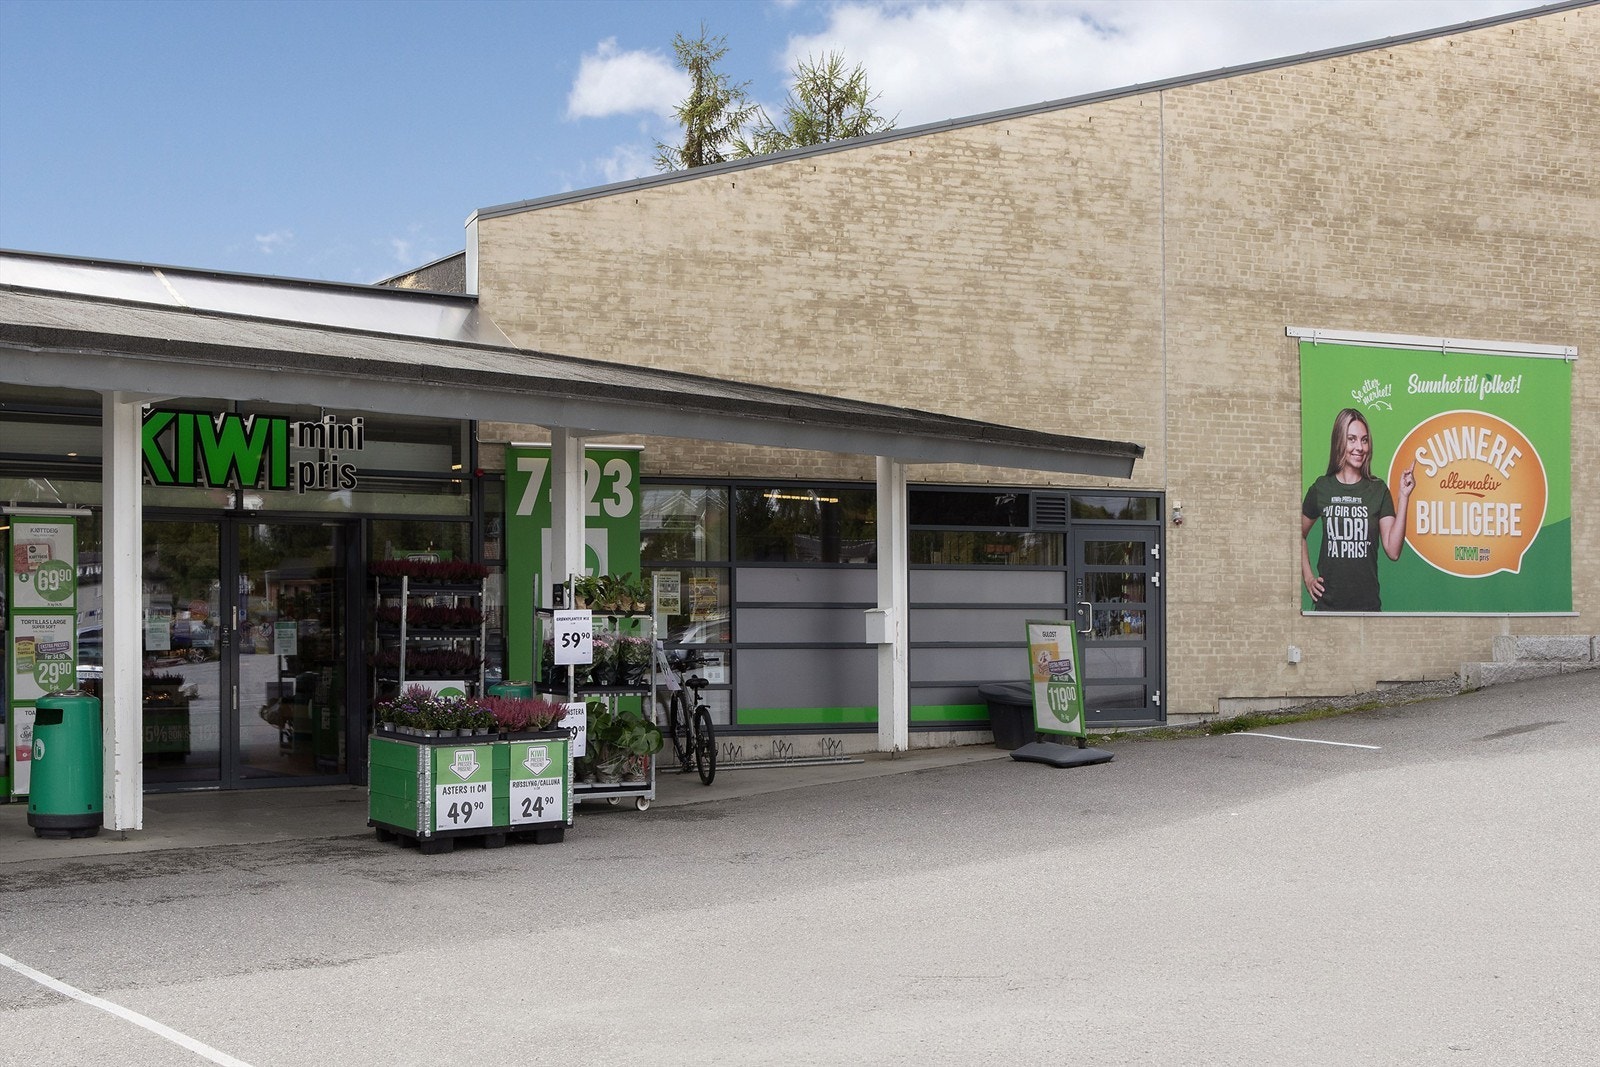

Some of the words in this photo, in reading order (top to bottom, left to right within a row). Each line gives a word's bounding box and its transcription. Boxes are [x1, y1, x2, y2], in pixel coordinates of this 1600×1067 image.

[1351, 390, 1363, 403] Se
[1361, 378, 1381, 392] etter
[1362, 384, 1392, 406] merket!
[1407, 373, 1462, 395] Sunnhet
[1463, 374, 1479, 394] til
[1479, 374, 1523, 400] folket!
[142, 408, 290, 490] KIWI
[295, 415, 364, 450] mini
[1415, 426, 1522, 479] SUNNERE
[295, 454, 358, 494] pris
[1440, 471, 1501, 491] alternativ
[1335, 505, 1349, 517] GIR
[1351, 506, 1368, 518] OSS
[1416, 500, 1522, 537] BILLIGERE
[1326, 516, 1369, 541] ALDRI
[1454, 546, 1479, 561] KIWI
[1480, 554, 1490, 562] pris
[458, 753, 472, 761] KIWI
[530, 750, 545, 758] KIWI
[442, 785, 468, 795] ASTERS
[477, 784, 487, 793] CM
